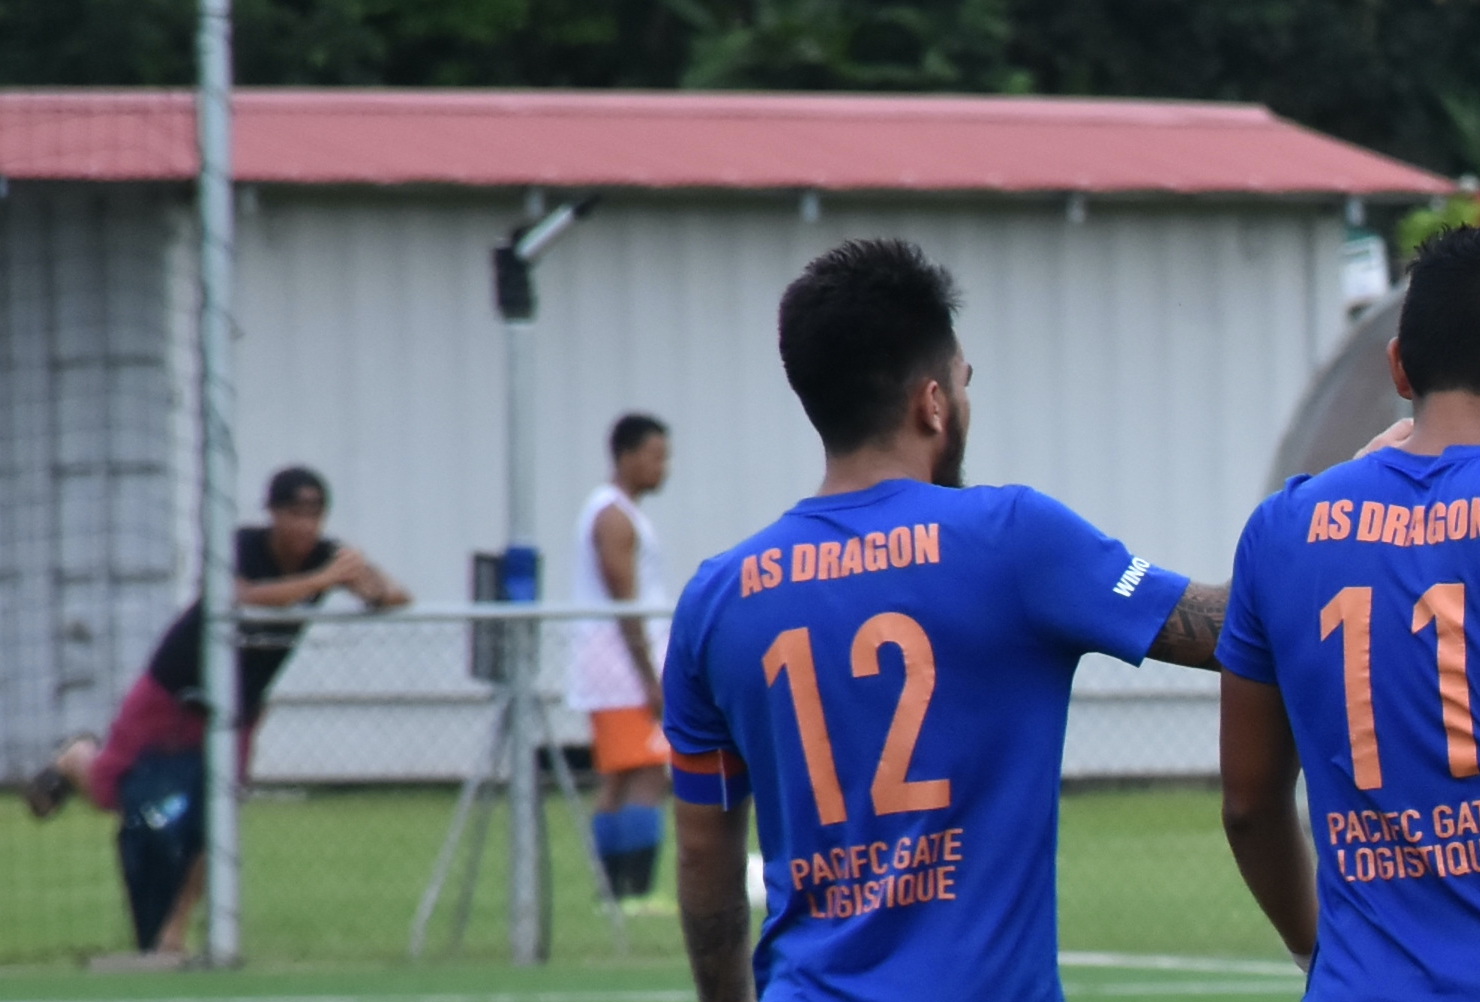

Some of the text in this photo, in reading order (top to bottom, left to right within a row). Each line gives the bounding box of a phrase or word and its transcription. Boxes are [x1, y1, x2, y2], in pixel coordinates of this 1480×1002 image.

[1307, 499, 1354, 543] AS
[741, 523, 940, 598] AS DRAGON
[761, 612, 951, 826] 12
[1320, 582, 1480, 790] 11
[892, 828, 964, 869] GATE
